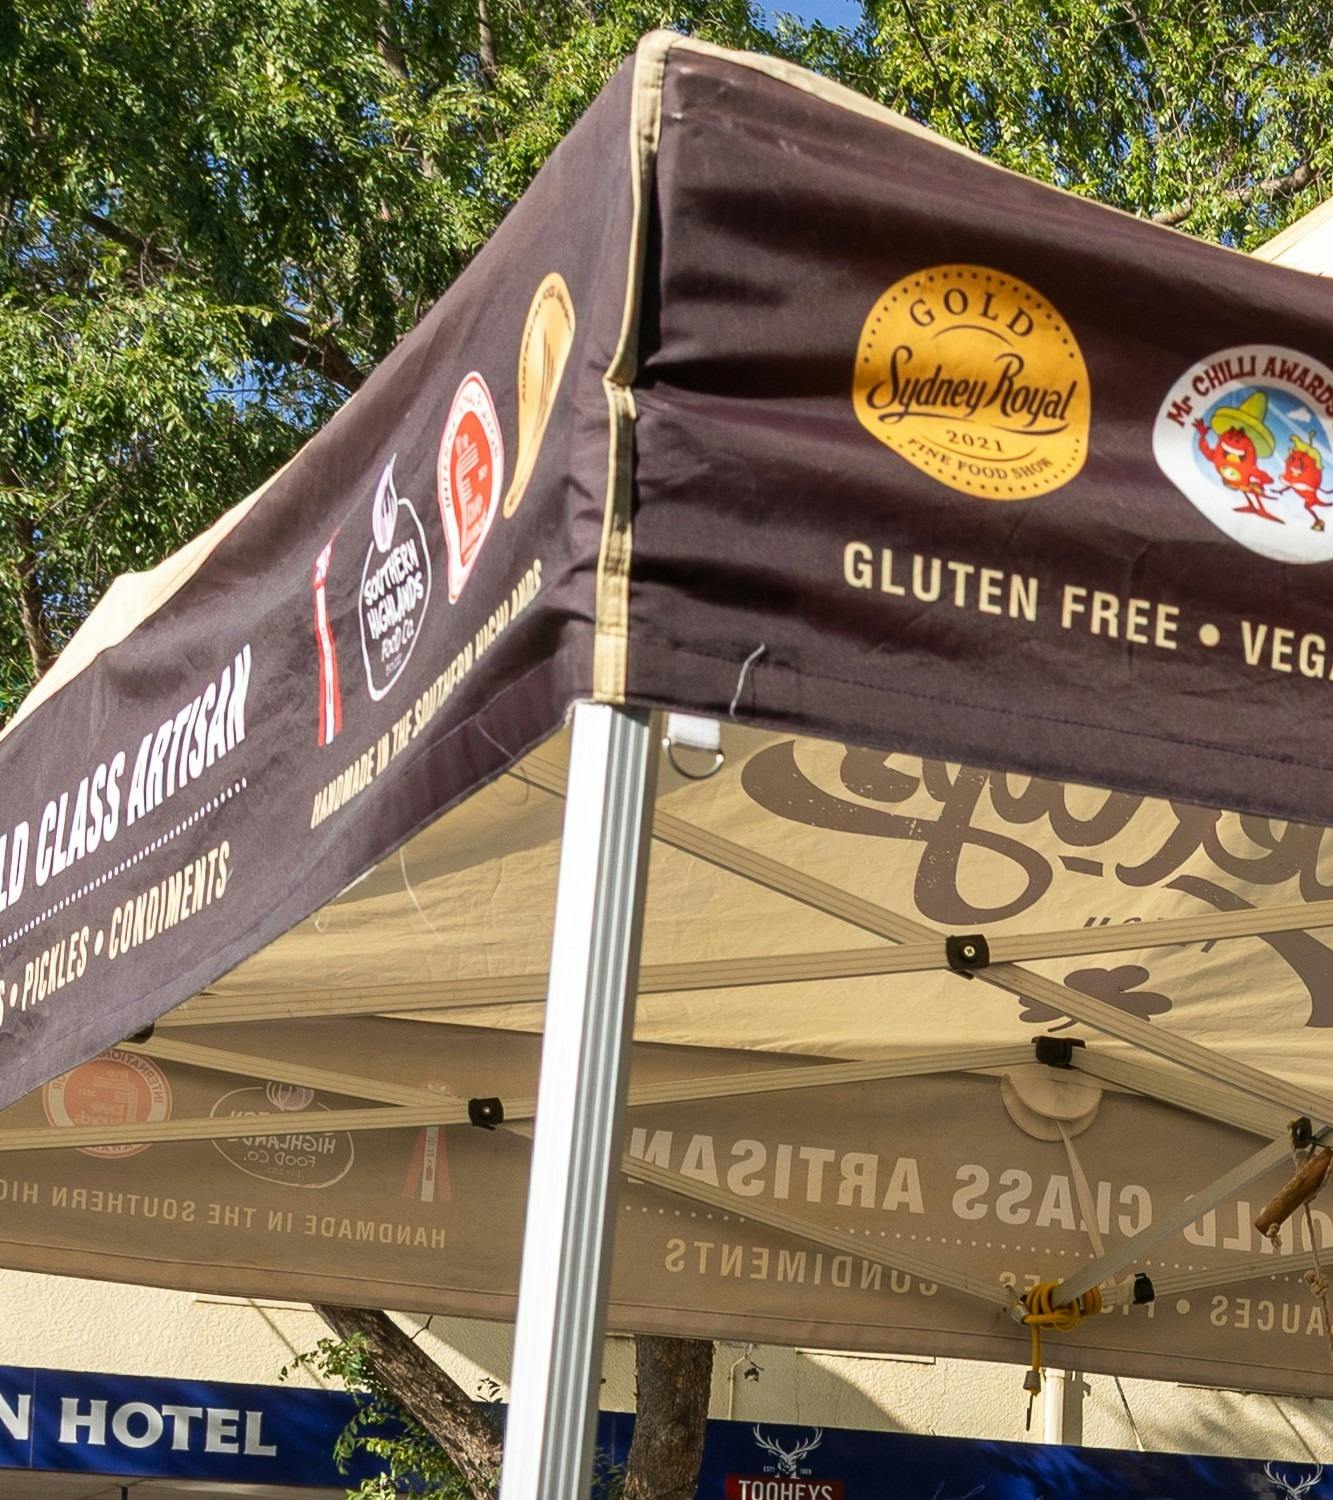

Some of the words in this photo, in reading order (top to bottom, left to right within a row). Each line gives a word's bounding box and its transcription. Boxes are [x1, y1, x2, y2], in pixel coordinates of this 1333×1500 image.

[907, 287, 1036, 339] GOLD
[866, 345, 986, 424] Sydney
[978, 352, 1077, 430] Royal
[1167, 395, 1194, 429] Mr
[1191, 355, 1258, 396] CHILLI
[907, 437, 951, 465] FINE
[956, 459, 1008, 481] FOOD
[1010, 457, 1054, 480] SHOW
[946, 429, 1005, 453] 2021
[363, 538, 421, 608] SOUTHERN
[368, 566, 424, 640] HIGHLANDS
[843, 541, 1038, 622] GLUTEN
[1061, 585, 1180, 650] FREE
[380, 624, 404, 661] FOOD
[35, 751, 125, 887] CLASS
[127, 643, 252, 827] ARTISAN
[310, 747, 374, 829] HANDMADE
[374, 731, 391, 778] IN
[390, 712, 413, 759] THE
[412, 639, 474, 744] SOUTHERN
[21, 926, 90, 1012] PICKLES
[108, 840, 230, 960] CONDIMENTS
[59, 1396, 277, 1457] HOTEL
